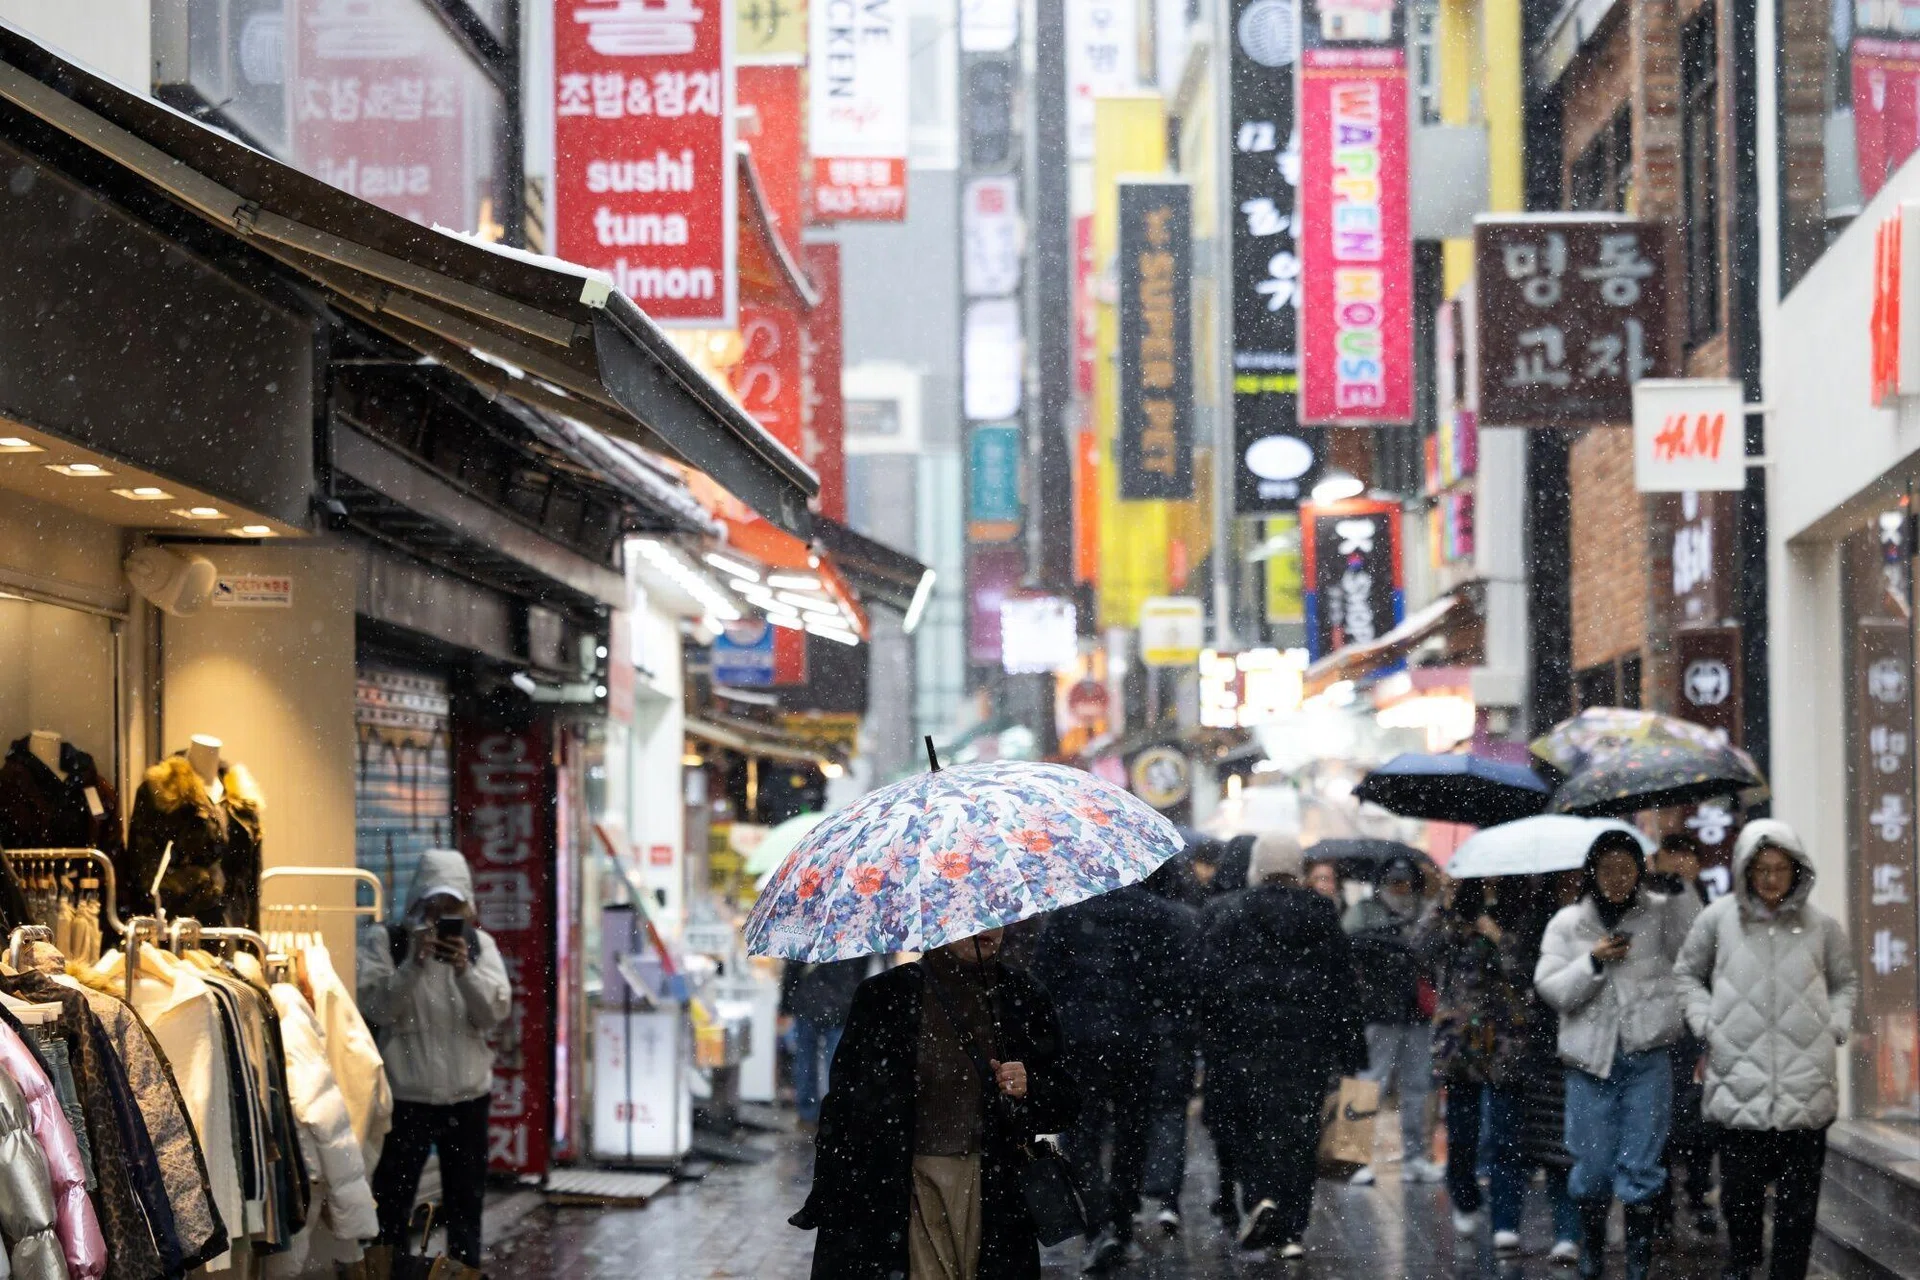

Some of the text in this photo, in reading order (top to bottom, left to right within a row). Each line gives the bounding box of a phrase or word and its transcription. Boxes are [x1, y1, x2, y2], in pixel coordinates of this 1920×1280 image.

[558, 72, 721, 118] 초밥&참치
[586, 150, 695, 194] sushi
[1332, 83, 1382, 261] WAPPEN
[593, 206, 690, 247] tuna
[602, 257, 717, 301] lmon
[1503, 232, 1655, 306] 명동
[1335, 267, 1386, 407] HOUSE
[1504, 317, 1655, 387] 교자
[1654, 412, 1726, 464] H&M
